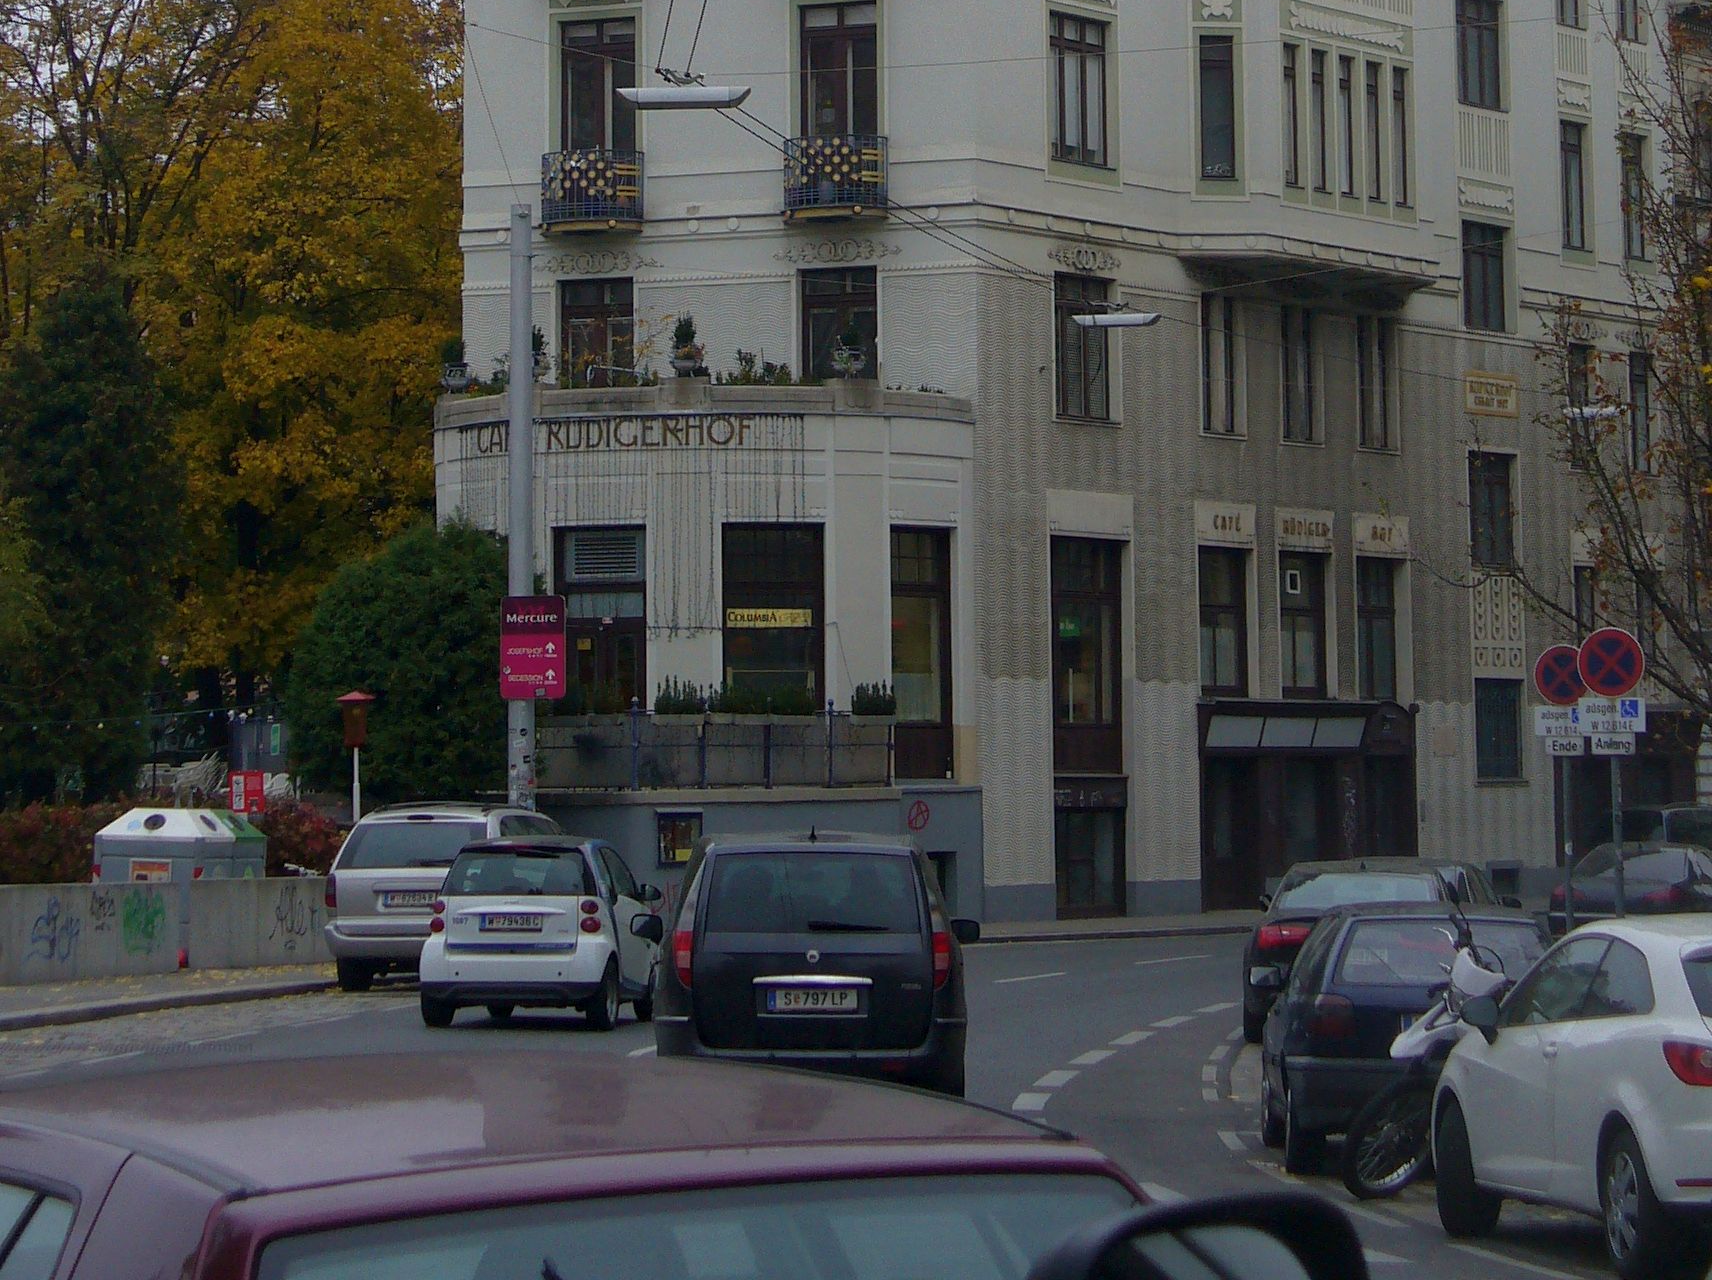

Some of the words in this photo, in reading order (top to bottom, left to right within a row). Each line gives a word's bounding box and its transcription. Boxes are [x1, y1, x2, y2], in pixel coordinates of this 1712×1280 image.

[477, 422, 510, 453] CA
[506, 613, 558, 624] Mercure
[1552, 740, 1578, 752] Ende
